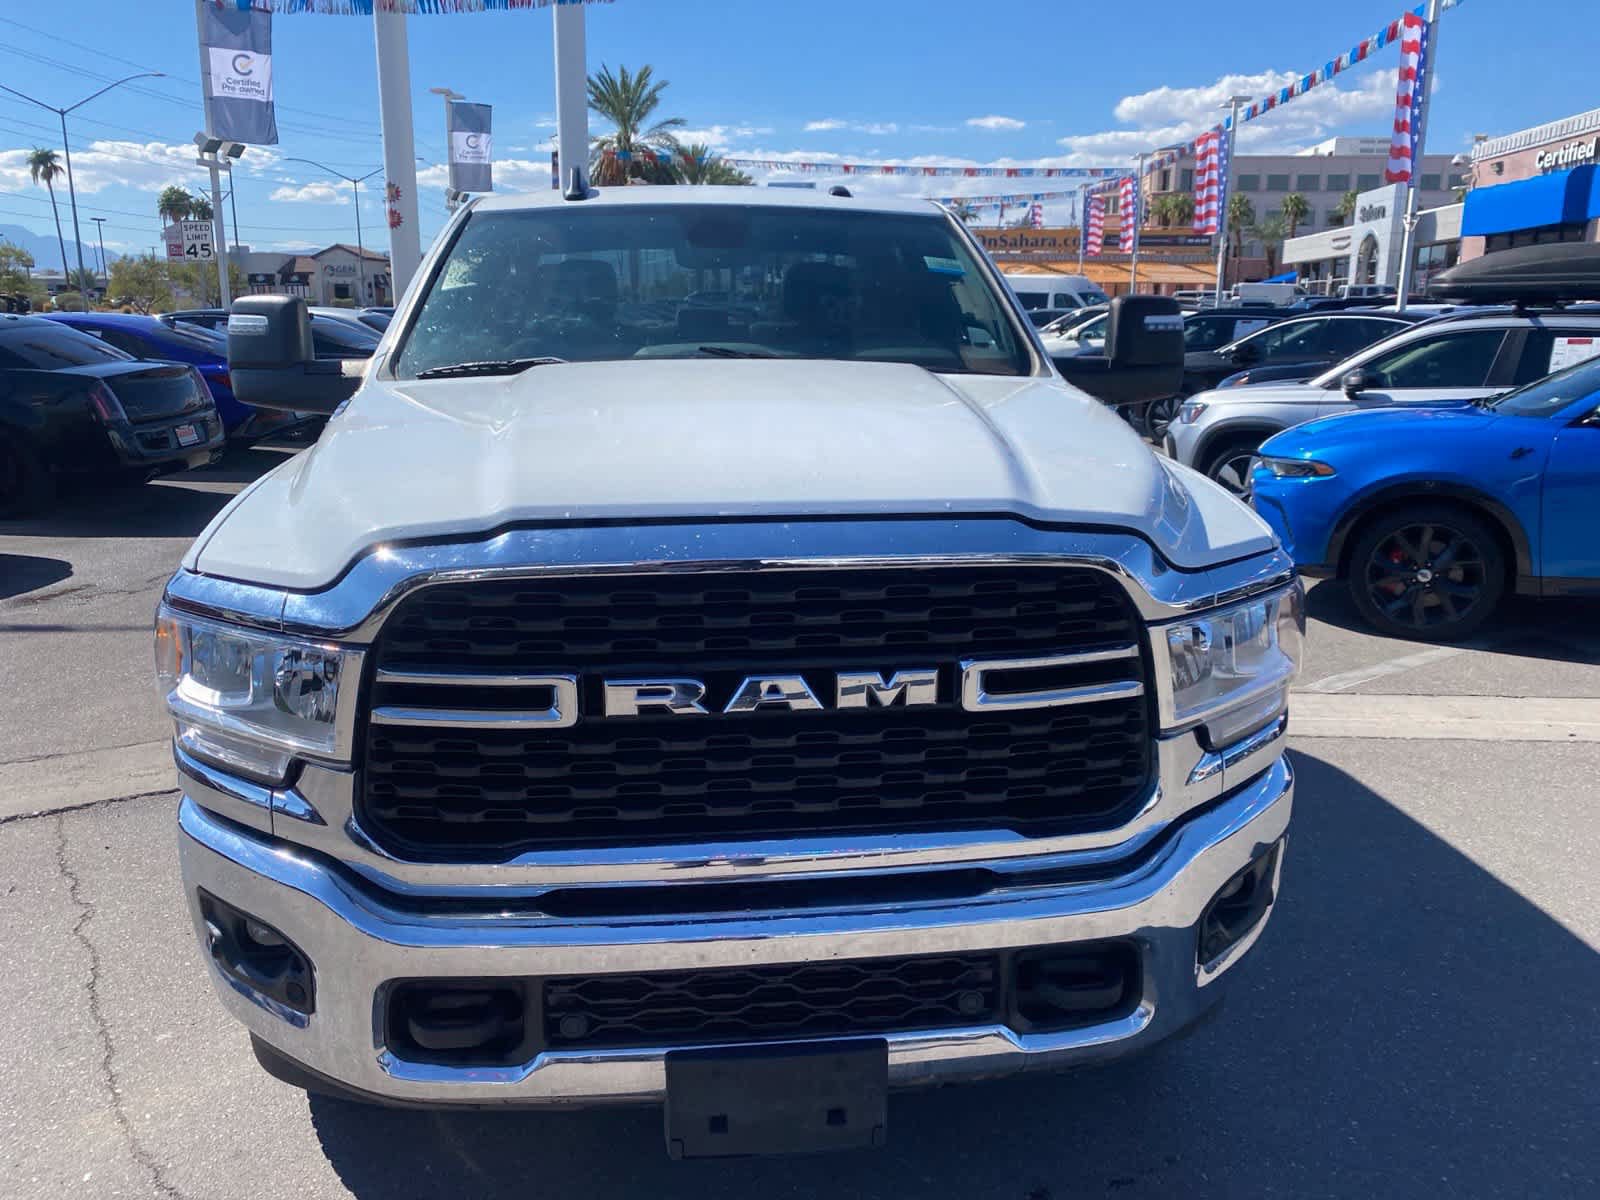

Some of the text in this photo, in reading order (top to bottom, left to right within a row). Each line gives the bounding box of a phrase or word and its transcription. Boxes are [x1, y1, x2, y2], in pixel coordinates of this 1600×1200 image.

[1535, 136, 1598, 169] Certified
[183, 224, 210, 232] SPEED
[186, 233, 208, 241] LIMIT
[976, 233, 1081, 248] OnSahara.co
[185, 243, 212, 258] 45
[604, 669, 940, 717] RAM
